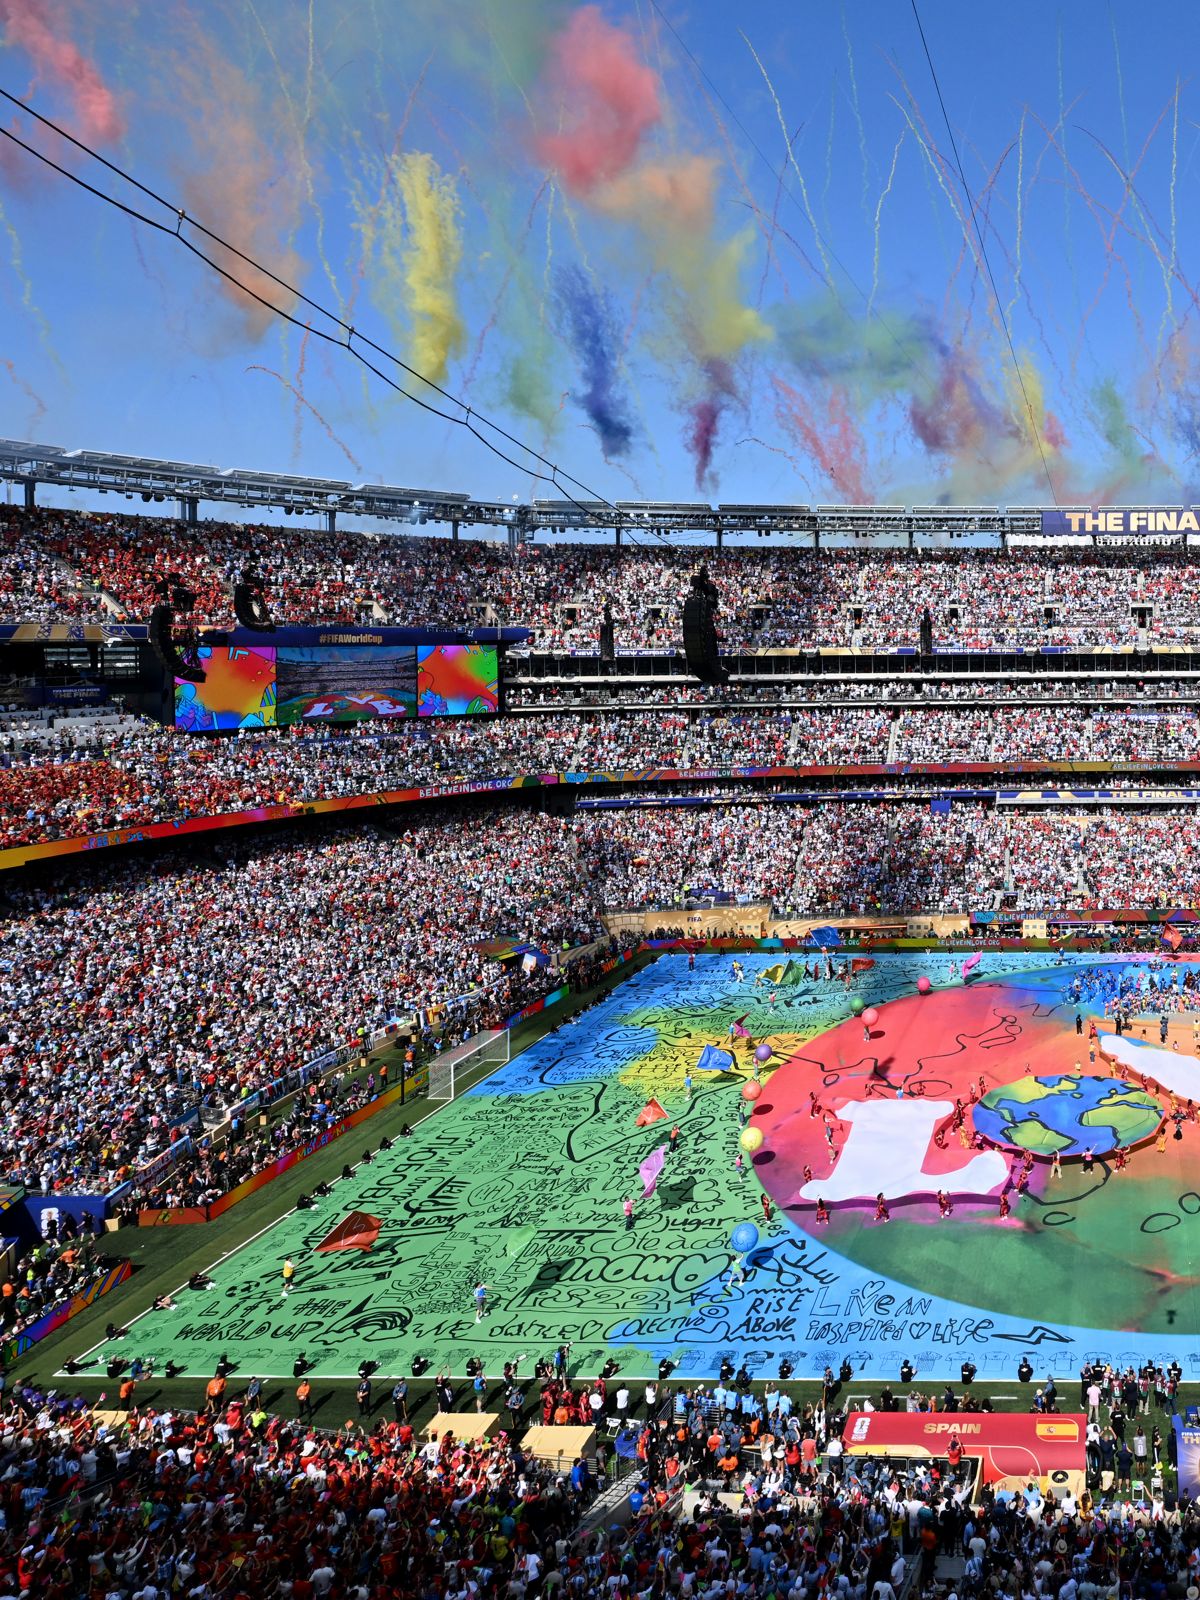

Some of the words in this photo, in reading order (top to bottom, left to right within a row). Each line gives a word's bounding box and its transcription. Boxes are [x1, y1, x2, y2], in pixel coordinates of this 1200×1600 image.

[1066, 512, 1124, 531] THE
[319, 633, 383, 645] #FIFAWorldCup
[419, 781, 513, 798] BELIEVEINLOVE.ORG
[1110, 791, 1139, 799] THE
[1142, 791, 1187, 799] FINAL
[516, 1177, 598, 1194] NEVER
[652, 1216, 737, 1233] jugar
[923, 1423, 981, 1434] SPAIN
